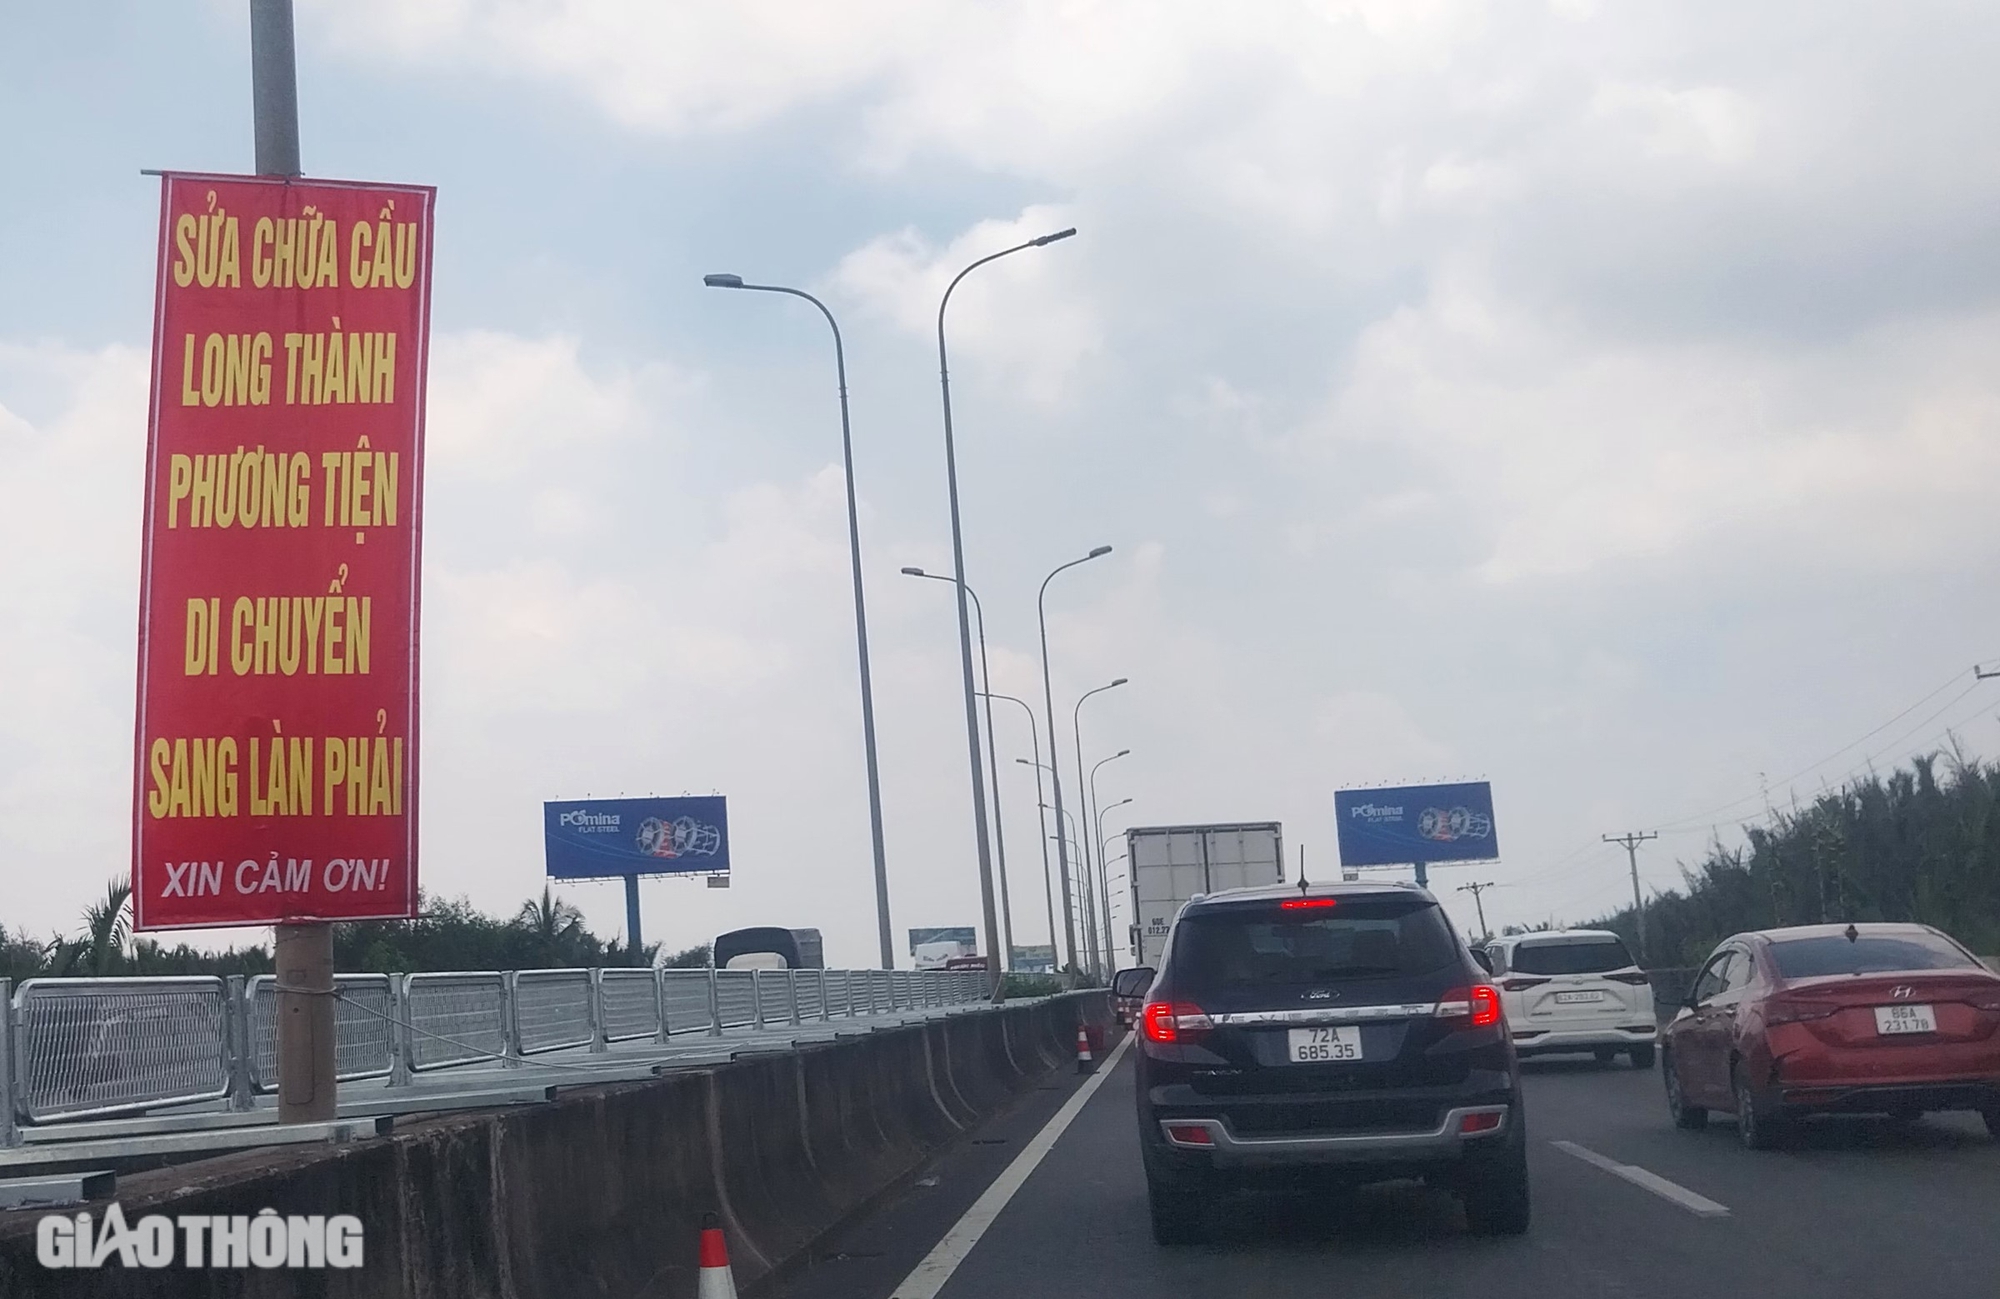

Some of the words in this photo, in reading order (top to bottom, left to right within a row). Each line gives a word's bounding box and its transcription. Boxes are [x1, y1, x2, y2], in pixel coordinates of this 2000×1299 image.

[174, 190, 241, 288] SỬA
[252, 205, 339, 289] CHỮA
[350, 199, 417, 289] CẦU
[182, 332, 273, 407] LONG
[284, 316, 396, 405] THÀNH
[168, 445, 310, 529] PHƯƠNG
[322, 435, 399, 544] TIỆN
[185, 597, 220, 676] DI
[231, 563, 371, 676] CHUYỂN
[149, 737, 238, 819] SANG
[250, 719, 313, 816] LÀN
[324, 708, 403, 816] PHẢI
[161, 861, 223, 897] XIN
[235, 851, 312, 893] CẢM
[324, 858, 390, 892] ƠN!
[597, 825, 620, 833] STEEL
[1298, 1043, 1355, 1060] 685.35
[1309, 1028, 1341, 1044] 72A
